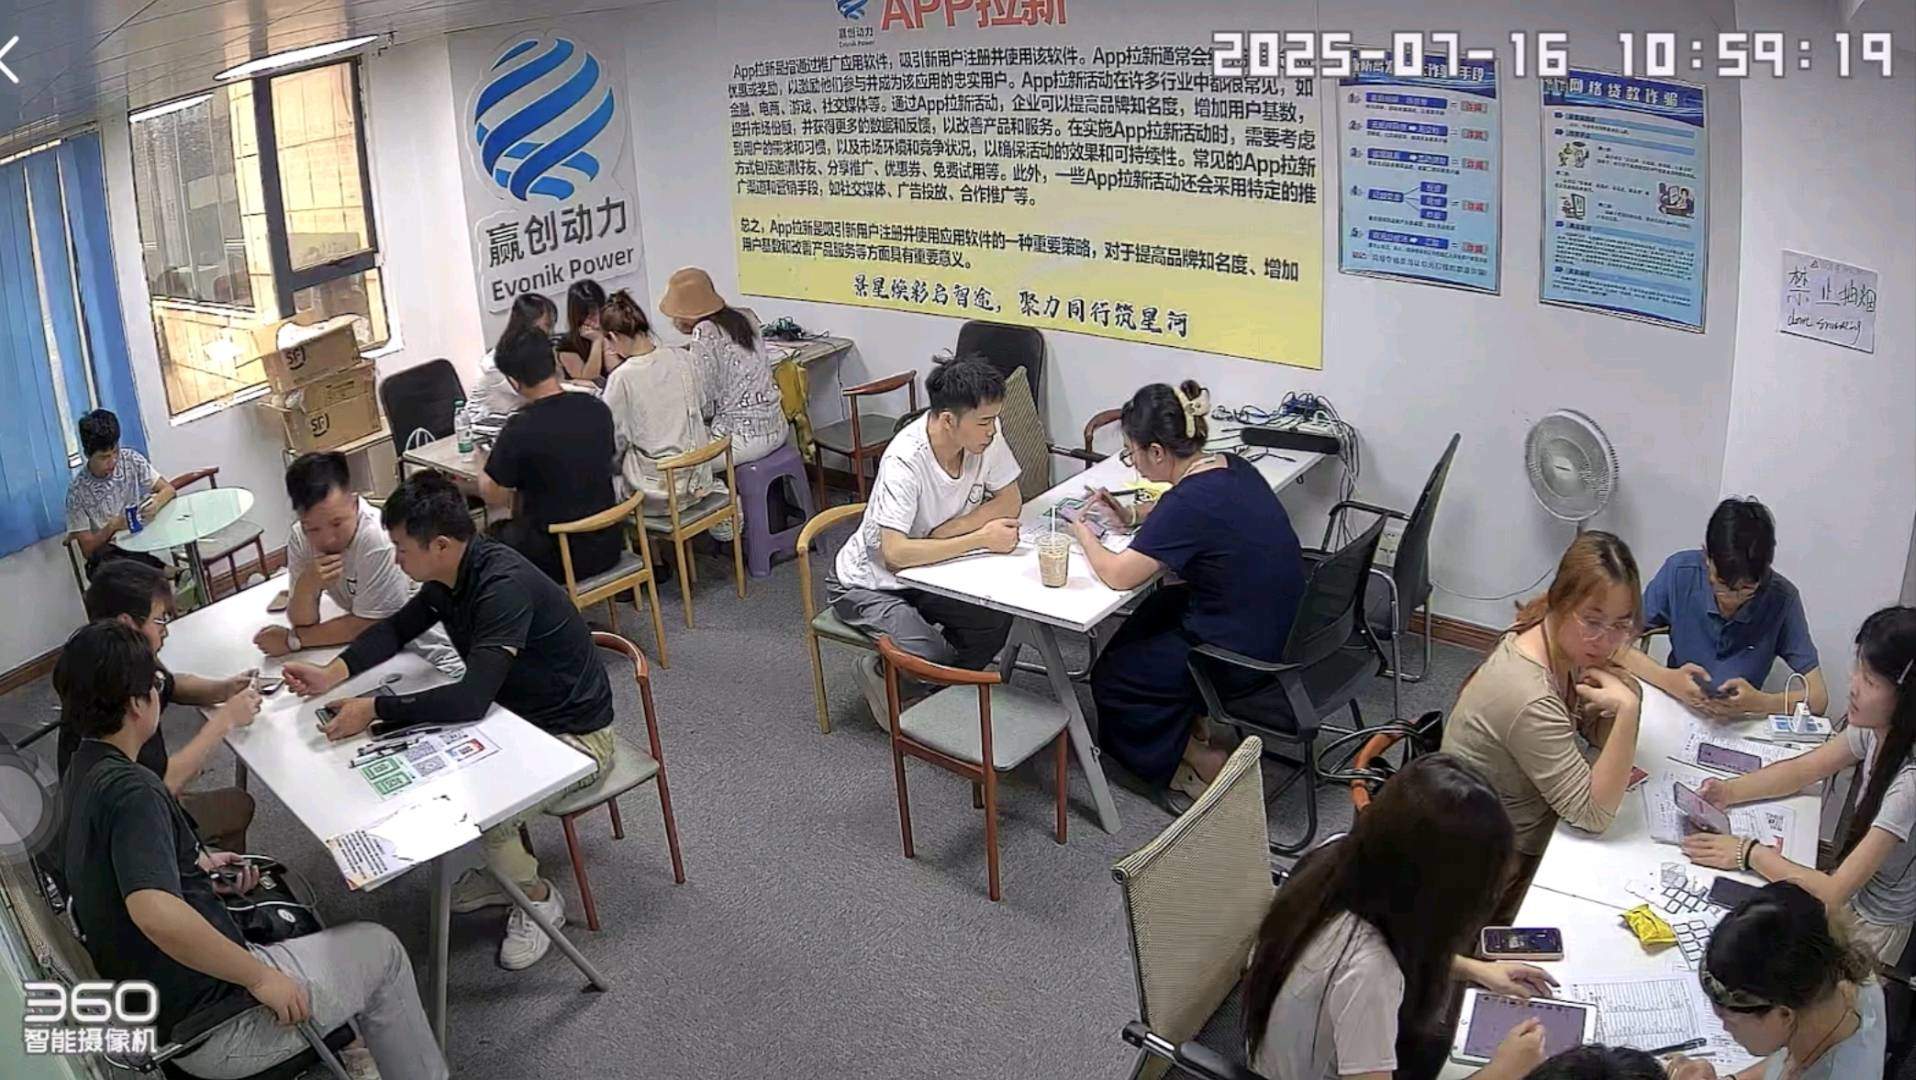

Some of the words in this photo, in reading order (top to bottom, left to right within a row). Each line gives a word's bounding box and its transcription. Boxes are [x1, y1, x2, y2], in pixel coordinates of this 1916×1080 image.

[486, 196, 627, 268] 赢创动力
[491, 263, 565, 302] Evonik
[569, 248, 635, 279] Power
